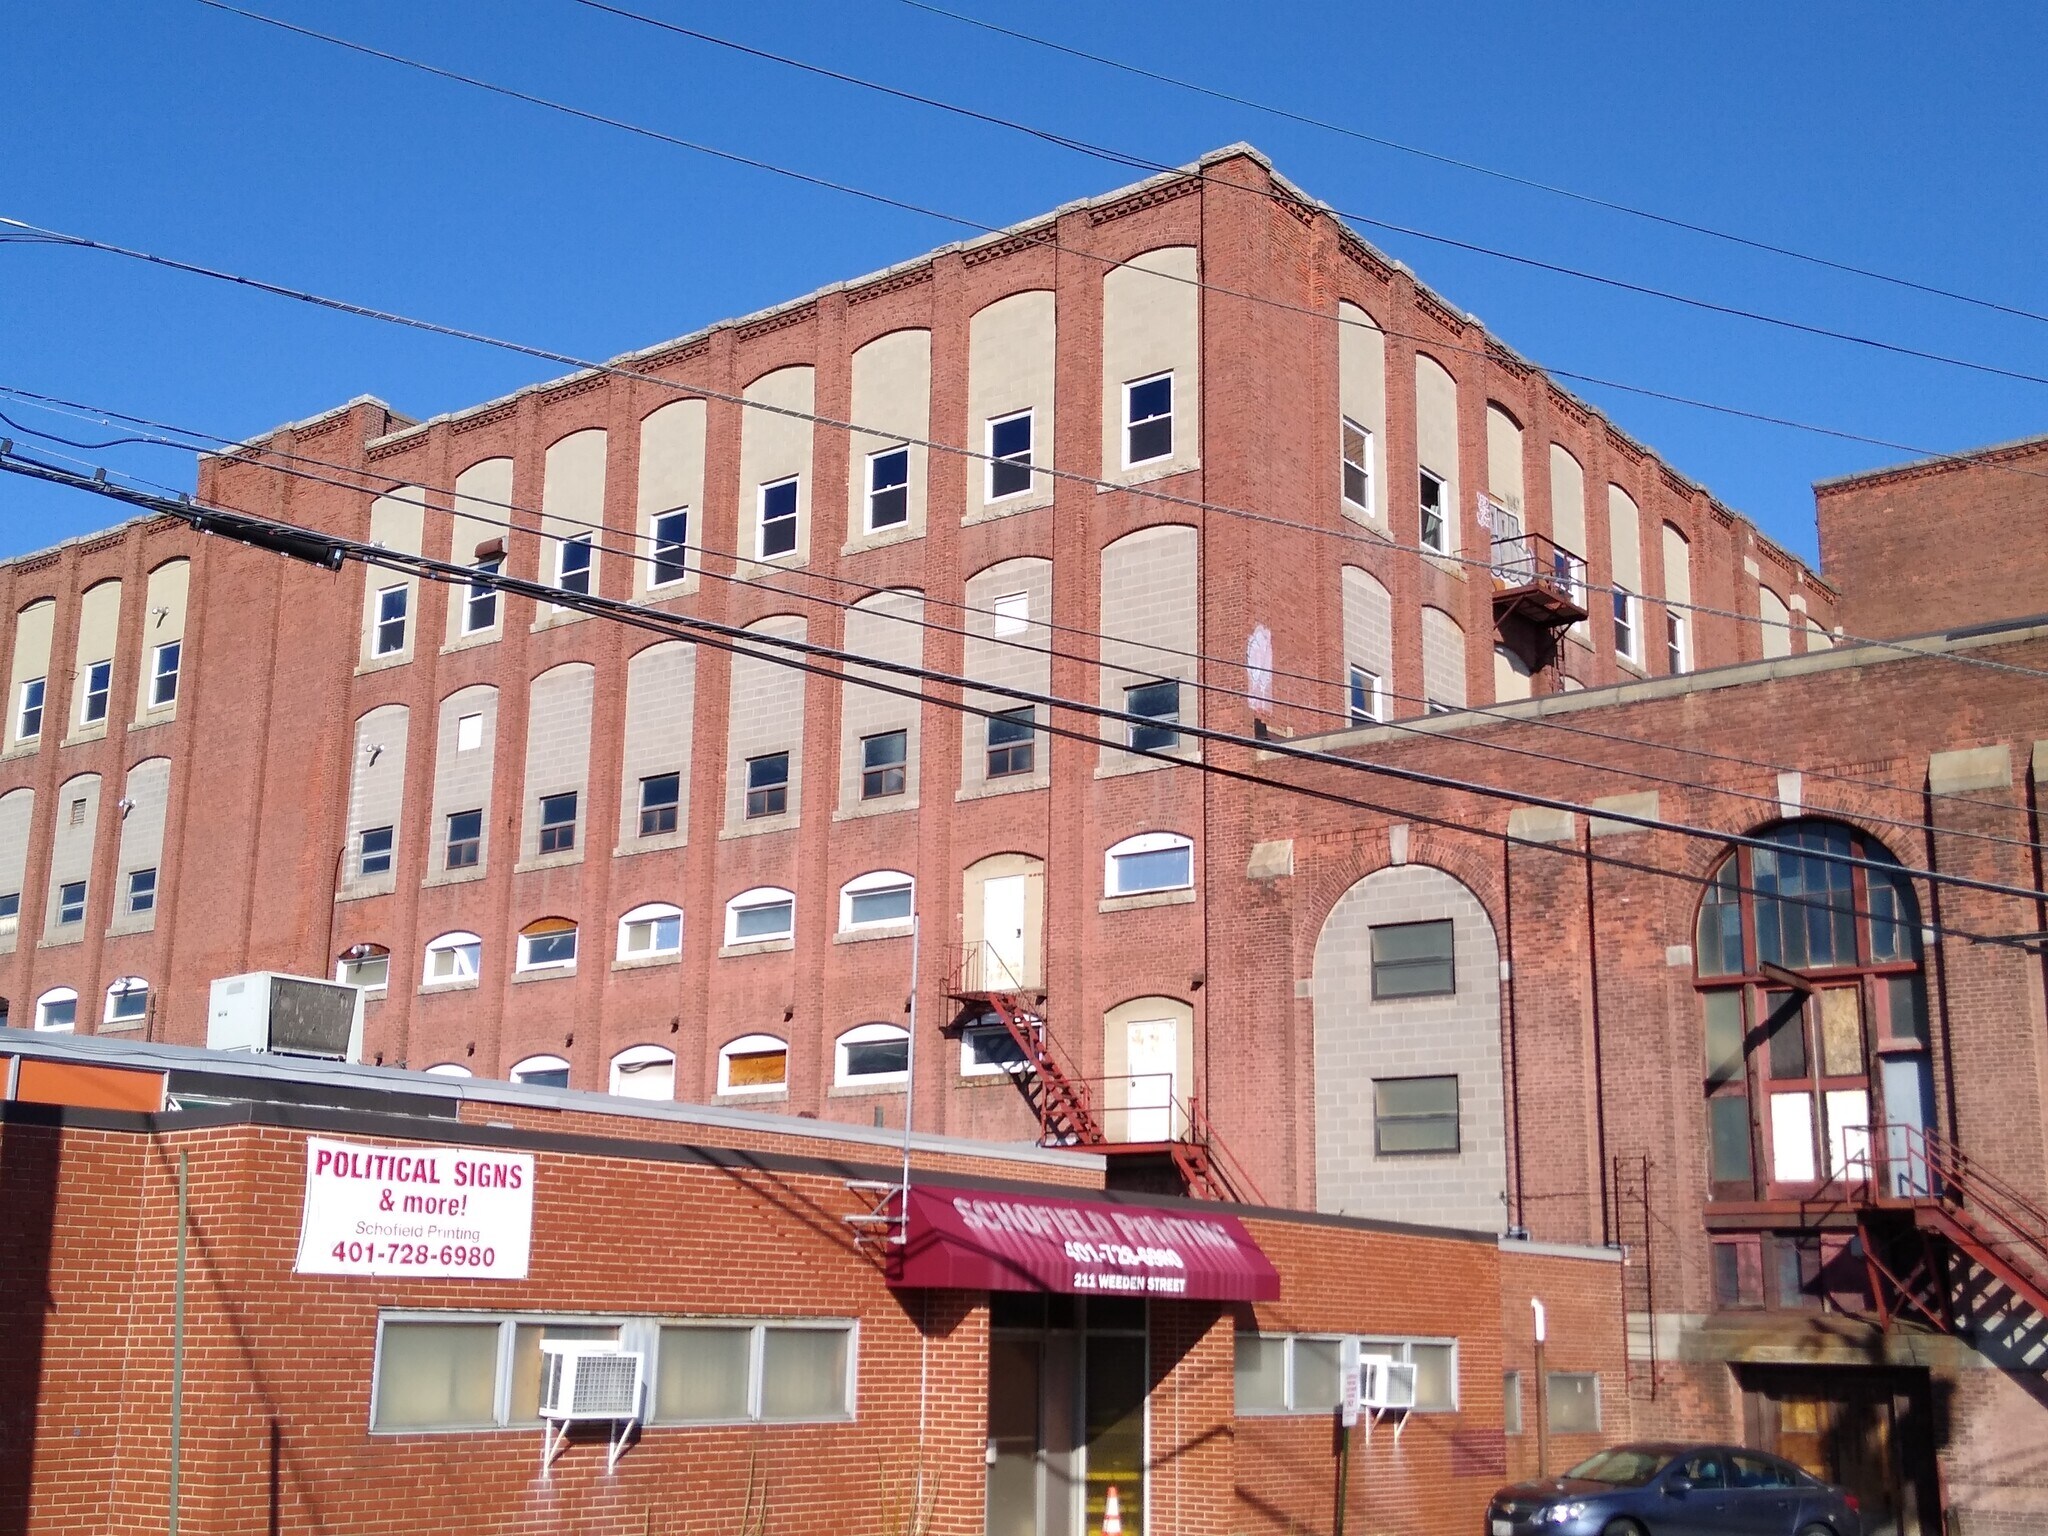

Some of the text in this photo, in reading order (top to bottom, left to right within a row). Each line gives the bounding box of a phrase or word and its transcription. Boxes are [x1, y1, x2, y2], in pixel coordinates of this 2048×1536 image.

[315, 1149, 522, 1189] POLITICAL SIGNS
[379, 1188, 467, 1216] & more!
[355, 1221, 480, 1243] Schofield Printing
[953, 1197, 1236, 1249] SCHOFIELD PRINTING
[331, 1241, 495, 1267] 401-728-6980
[1073, 1272, 1186, 1293] 211 WEEDEN STREET
